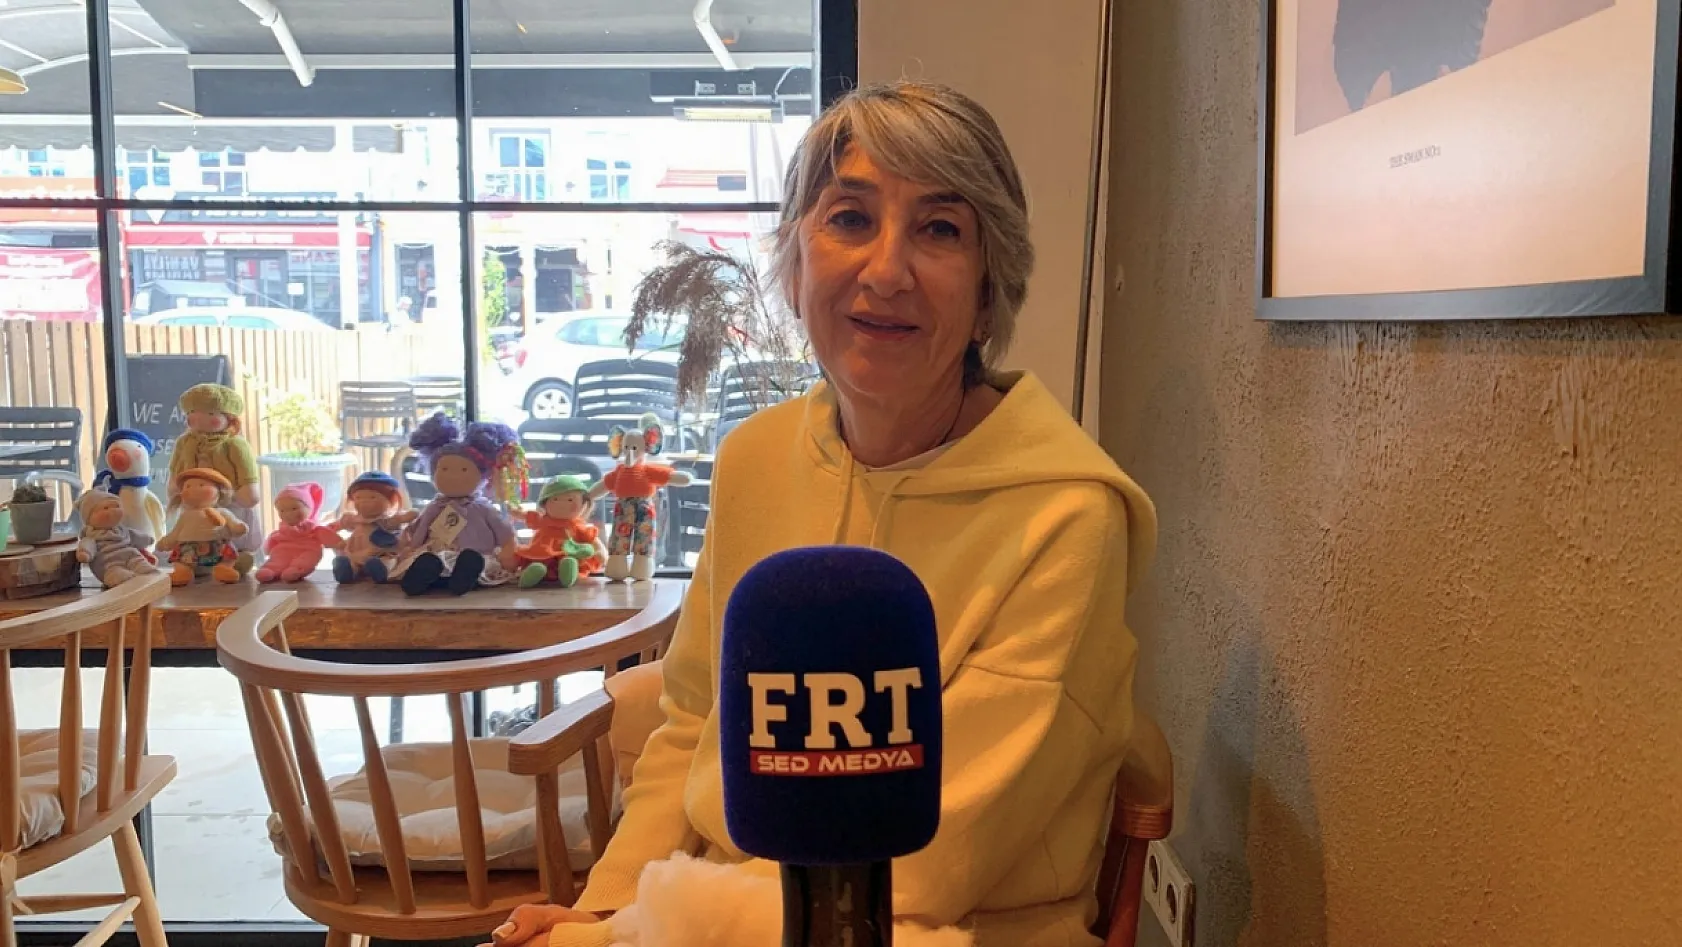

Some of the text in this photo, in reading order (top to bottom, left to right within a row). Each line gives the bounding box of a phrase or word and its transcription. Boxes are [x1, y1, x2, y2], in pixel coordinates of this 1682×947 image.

[133, 402, 163, 425] WE
[747, 667, 923, 749] FRT
[757, 750, 915, 773] SED MEDYA
